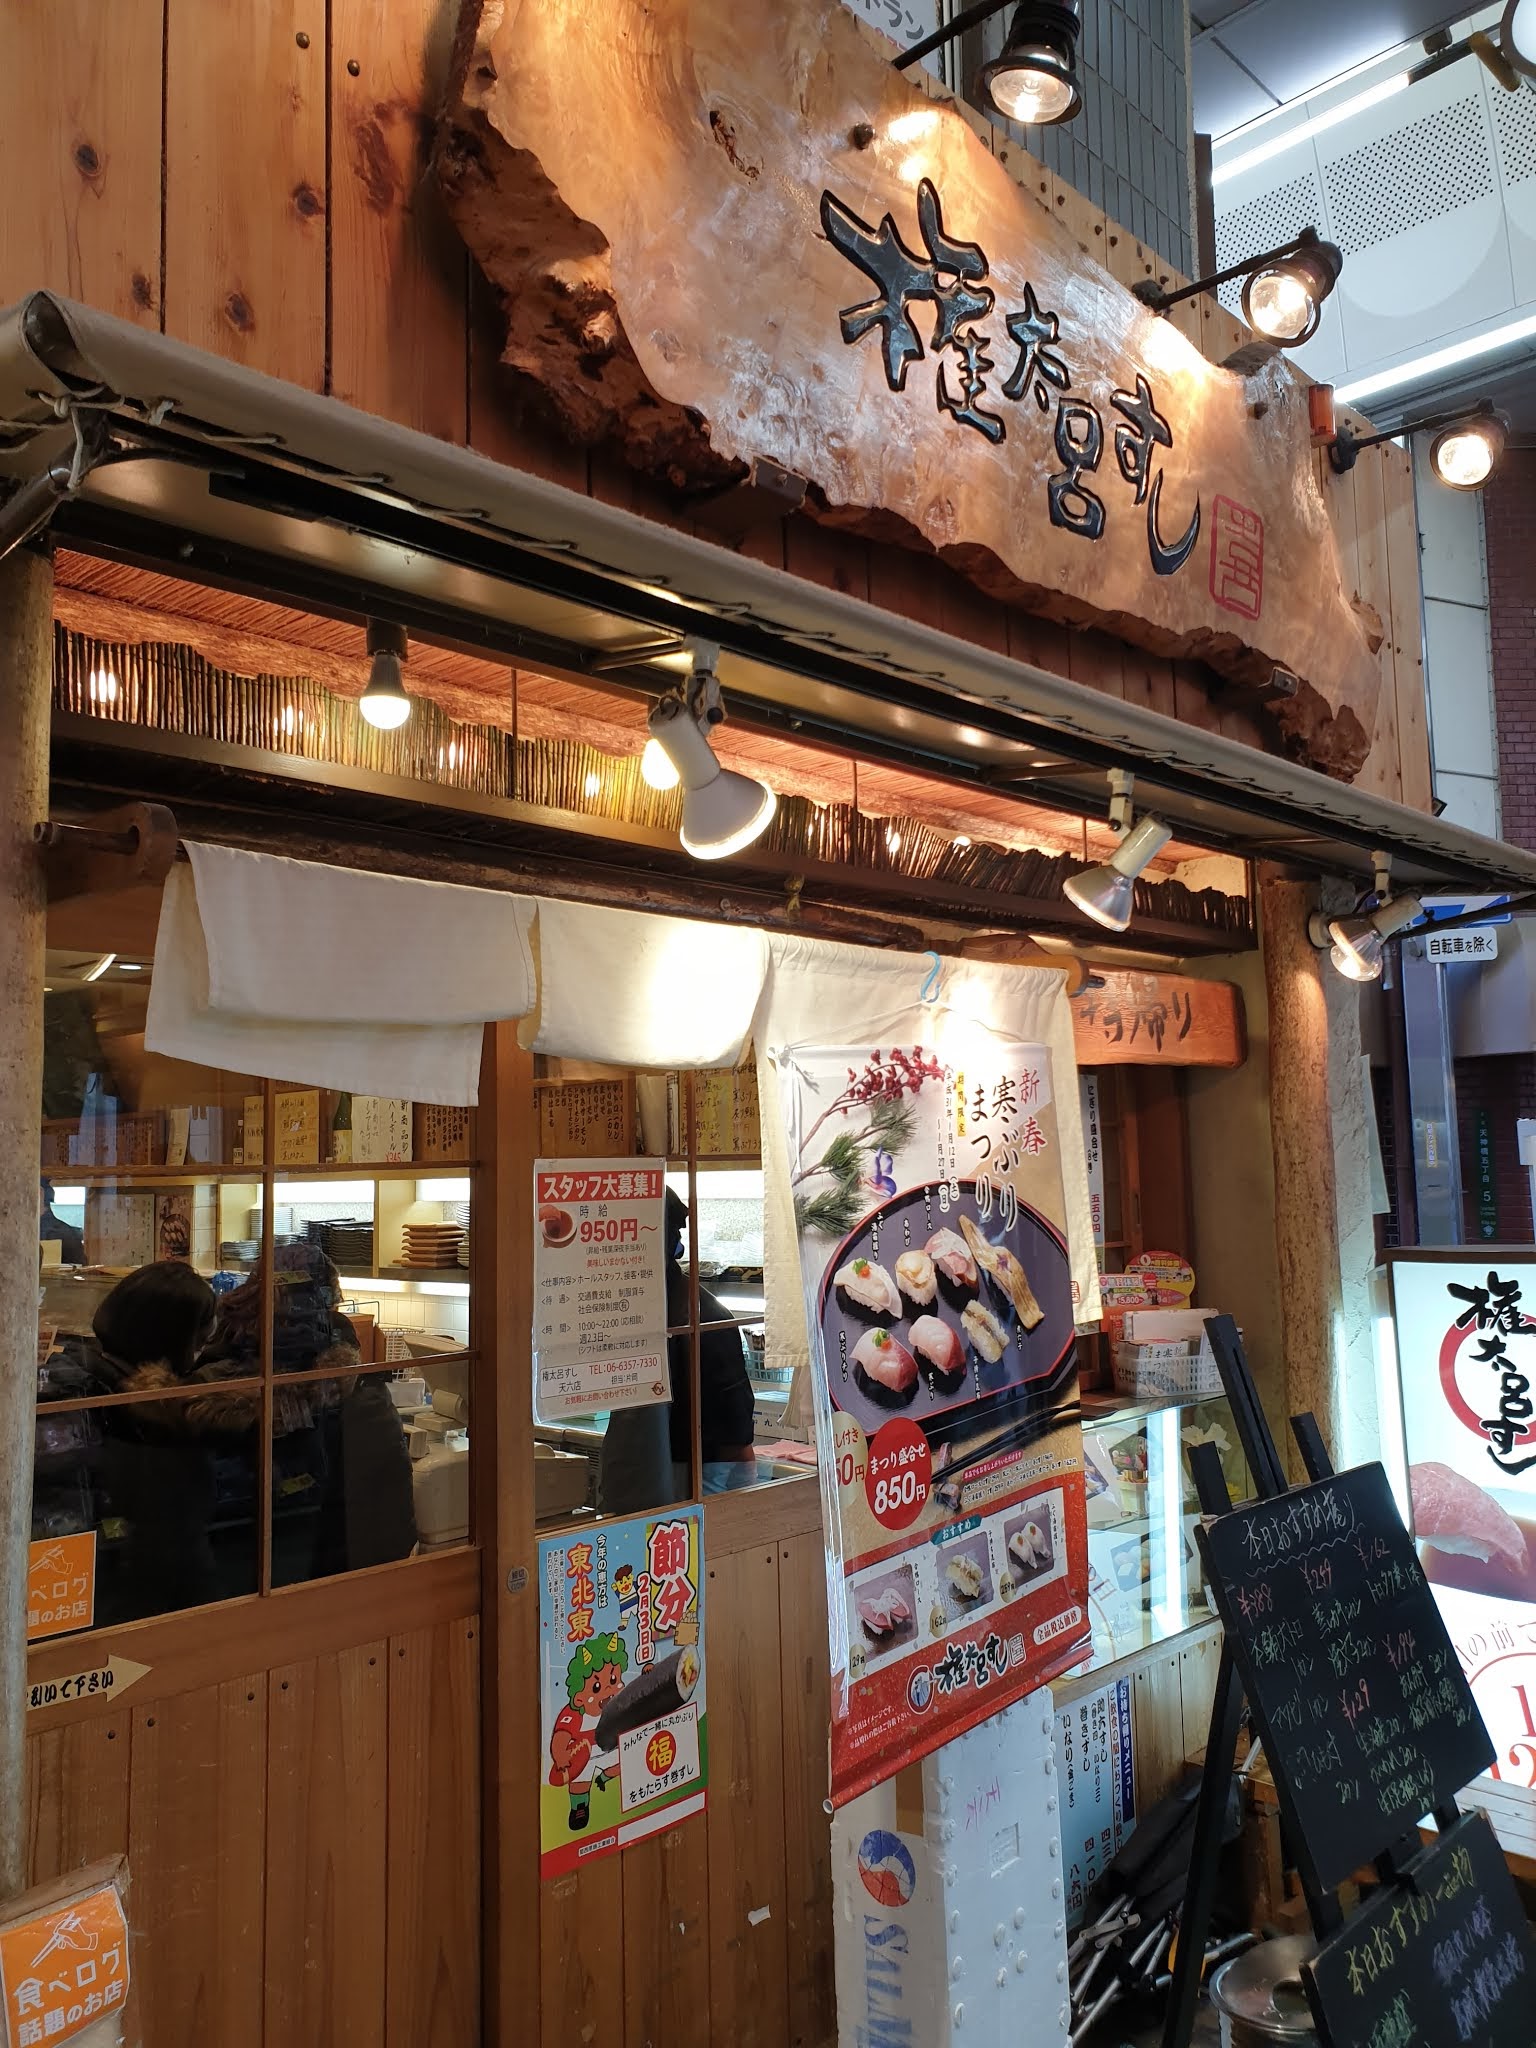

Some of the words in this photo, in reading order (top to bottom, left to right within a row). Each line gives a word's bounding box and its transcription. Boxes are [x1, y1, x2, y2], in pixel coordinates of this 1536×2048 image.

[1430, 936, 1494, 955] 自転車を除く
[956, 1072, 967, 1136] 期間限定
[1018, 1068, 1048, 1155] 新春
[970, 1084, 993, 1219] まつり
[991, 1075, 1020, 1233] 寒ぶり
[543, 1173, 656, 1200] スタッフ大募集!
[1483, 1190, 1492, 1202] 5
[577, 1289, 612, 1303] 交通費支給
[618, 1286, 645, 1299] 制服貸与
[542, 1367, 578, 1382] 権太呂すし
[589, 1357, 658, 1376] TEL:06-6357-7330
[558, 1379, 582, 1394] 天六店
[869, 1442, 927, 1474] まつり盛合せ
[874, 1471, 926, 1516] 850円
[941, 1519, 972, 1541] おすすめ
[596, 1534, 608, 1609] 今年の恵方は
[650, 1521, 695, 1630] 節分
[568, 1543, 595, 1642] 東北東
[1036, 1610, 1079, 1642] 全品税込価格
[27, 1670, 114, 1708] 引いて下さい
[622, 1710, 694, 1752] みんなで一緒に丸かぶり
[649, 1738, 674, 1773] 福
[628, 1764, 694, 1804] をもたらす巻ずし
[13, 1940, 122, 2016] 食べログ
[18, 1979, 124, 2048] 話題のお店
